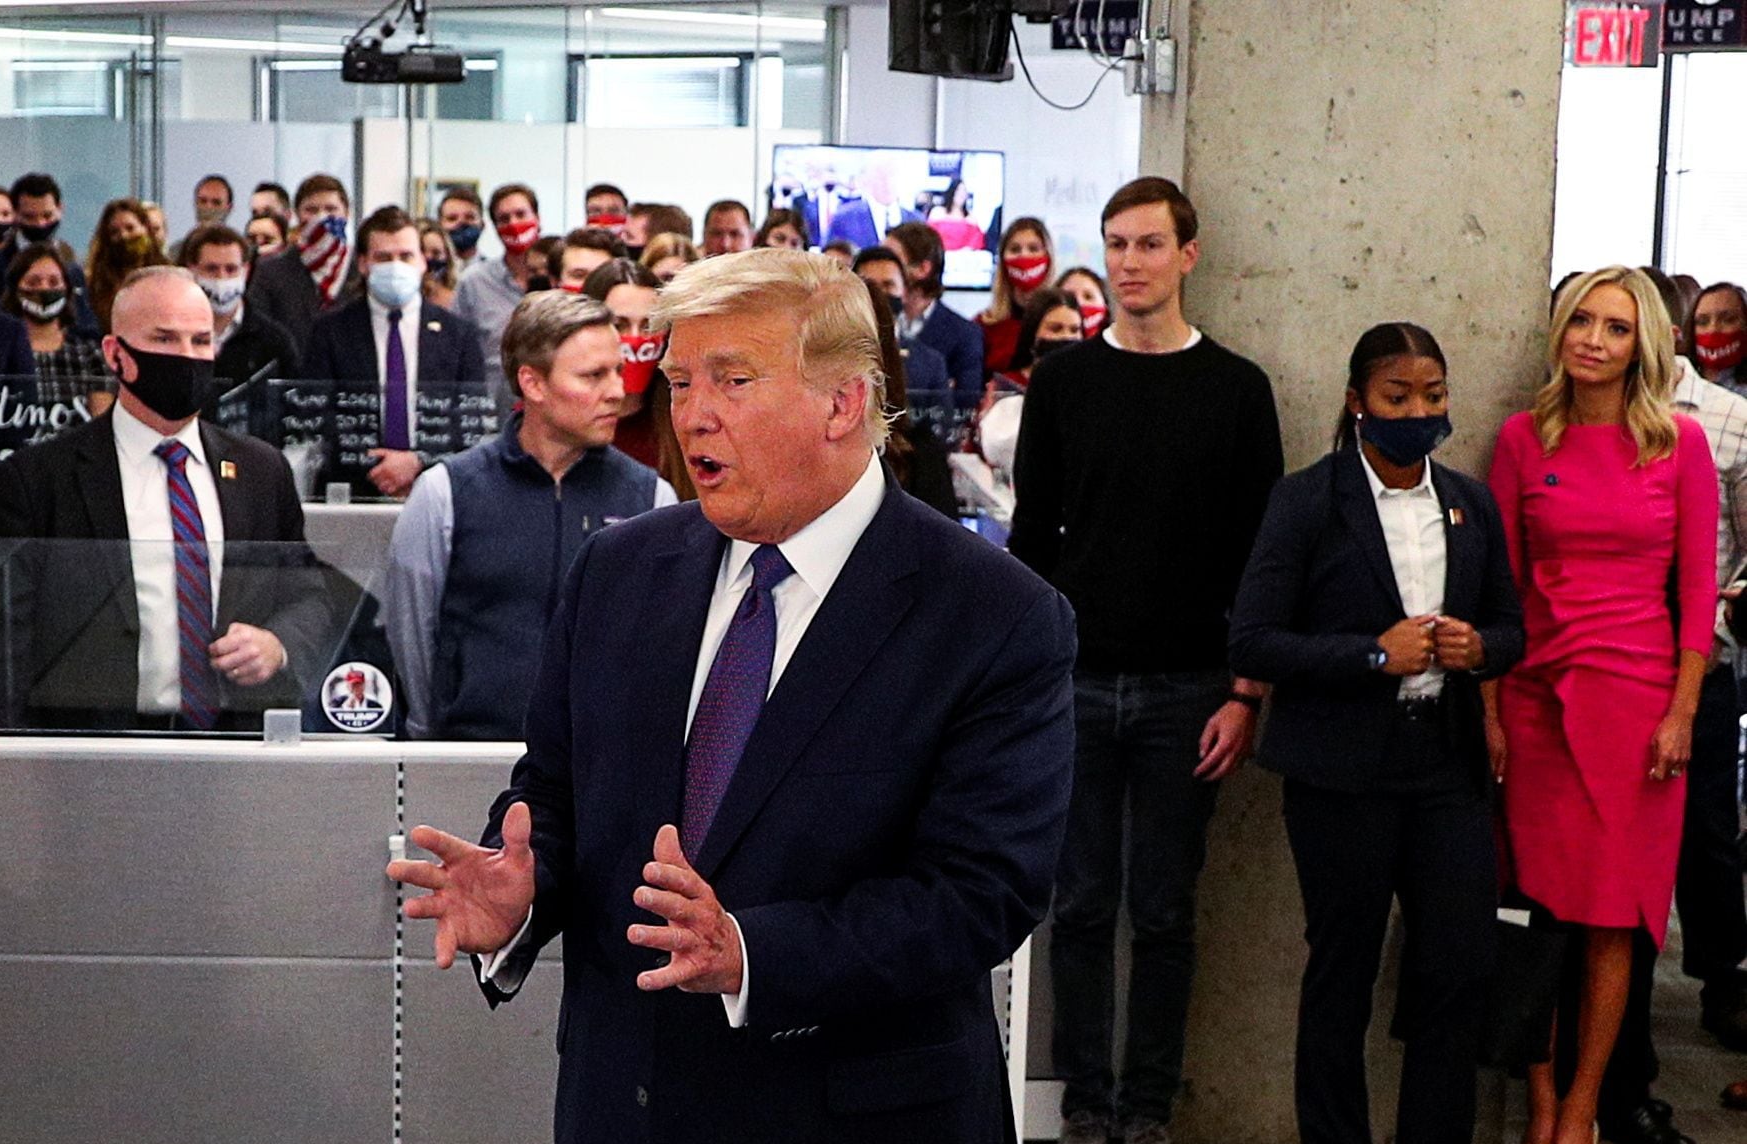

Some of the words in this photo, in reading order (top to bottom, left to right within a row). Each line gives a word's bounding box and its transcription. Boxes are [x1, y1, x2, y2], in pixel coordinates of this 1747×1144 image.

[1667, 9, 1735, 27] UMP
[1575, 9, 1650, 65] EXIT
[1672, 29, 1724, 42] NCE
[336, 712, 378, 721] TRUMP
